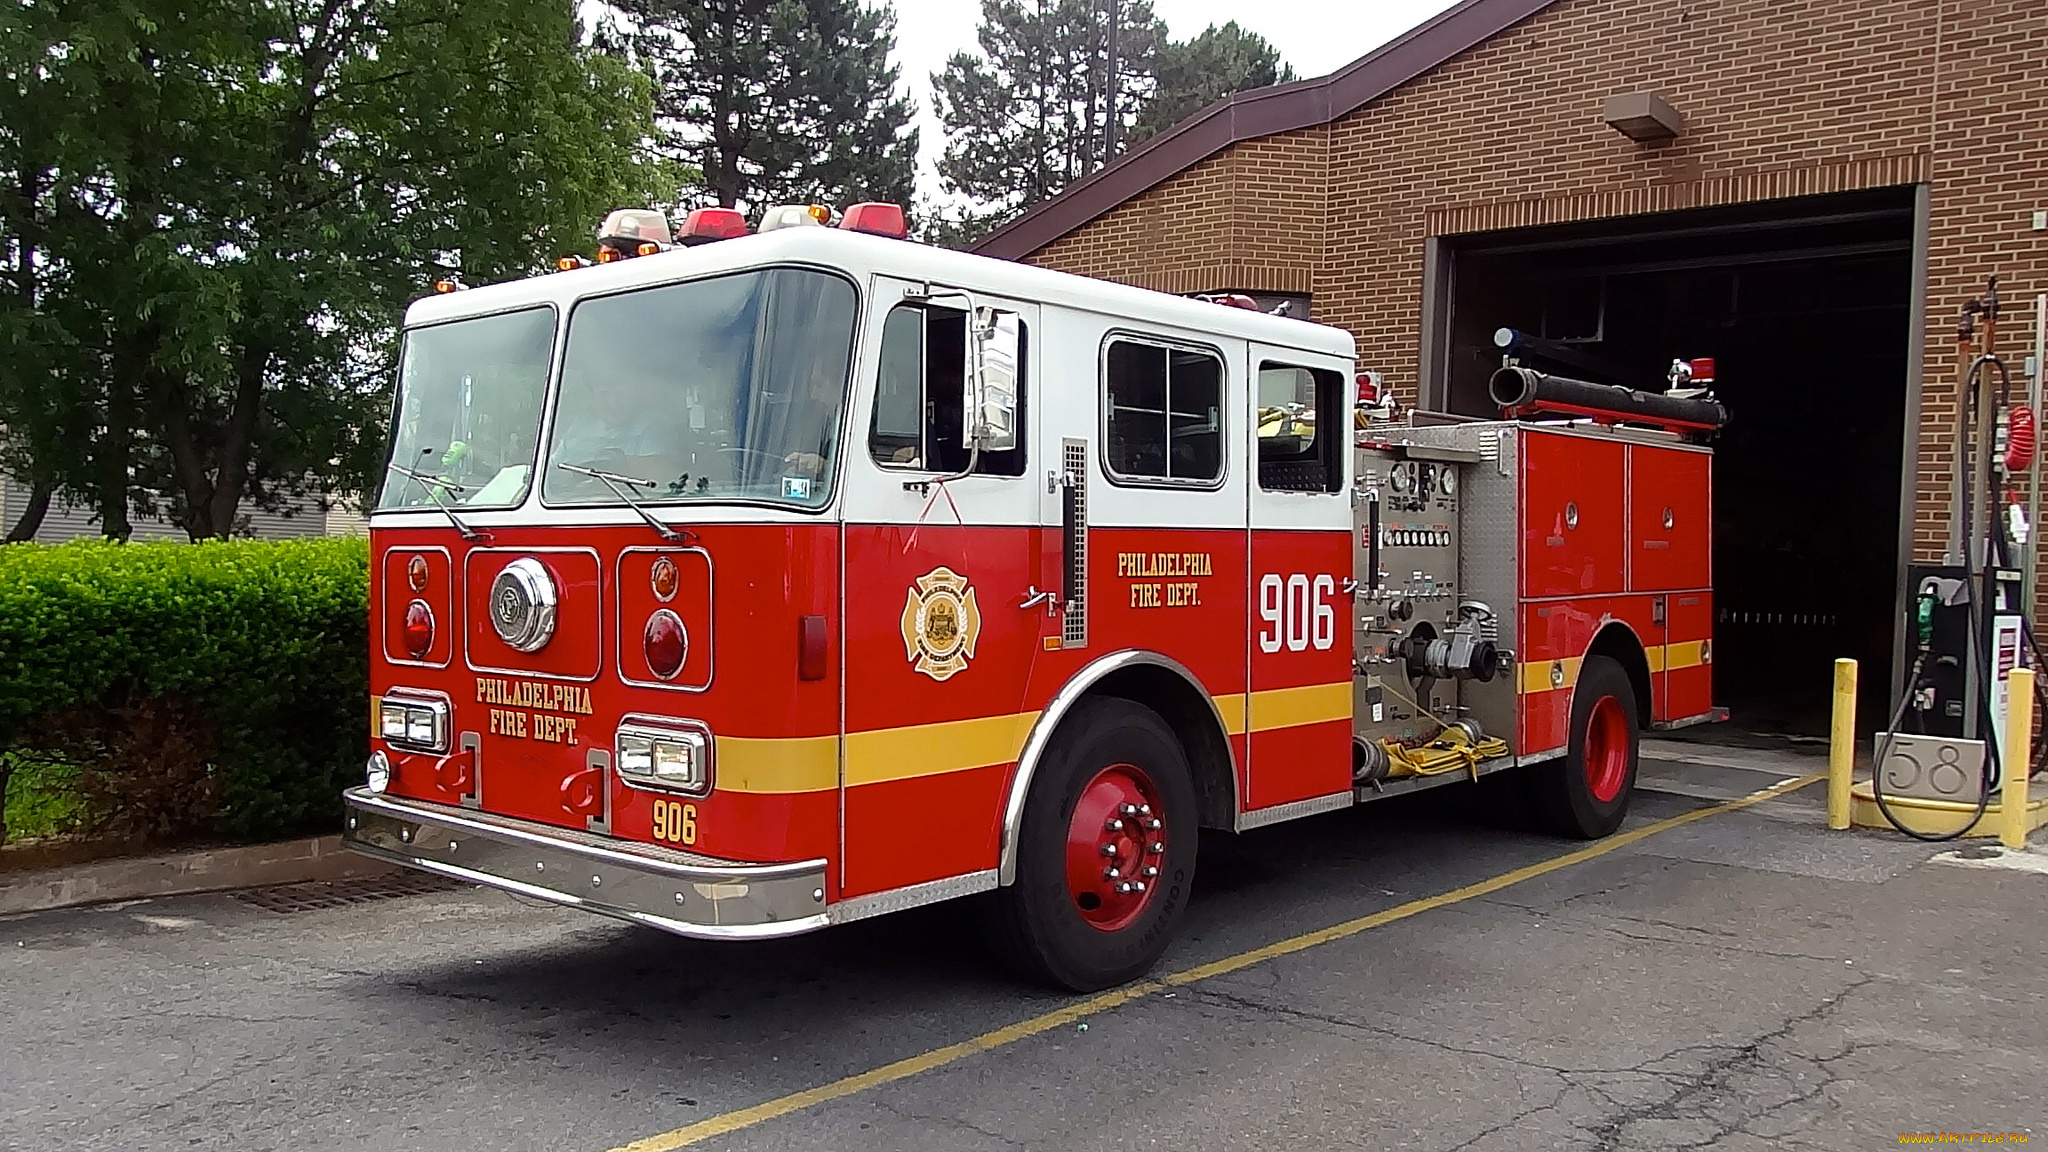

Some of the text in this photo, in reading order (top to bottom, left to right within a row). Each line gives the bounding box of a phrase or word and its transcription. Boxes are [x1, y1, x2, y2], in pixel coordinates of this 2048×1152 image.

[1118, 552, 1213, 577] PHILADELPHIA
[1130, 582, 1202, 608] FIRE DEPT.
[1259, 573, 1334, 653] 906
[476, 677, 593, 715] PHILADELPHIA
[489, 708, 579, 745] FIRE DEPT.
[1887, 740, 1968, 795] 58
[653, 799, 697, 845] 906
